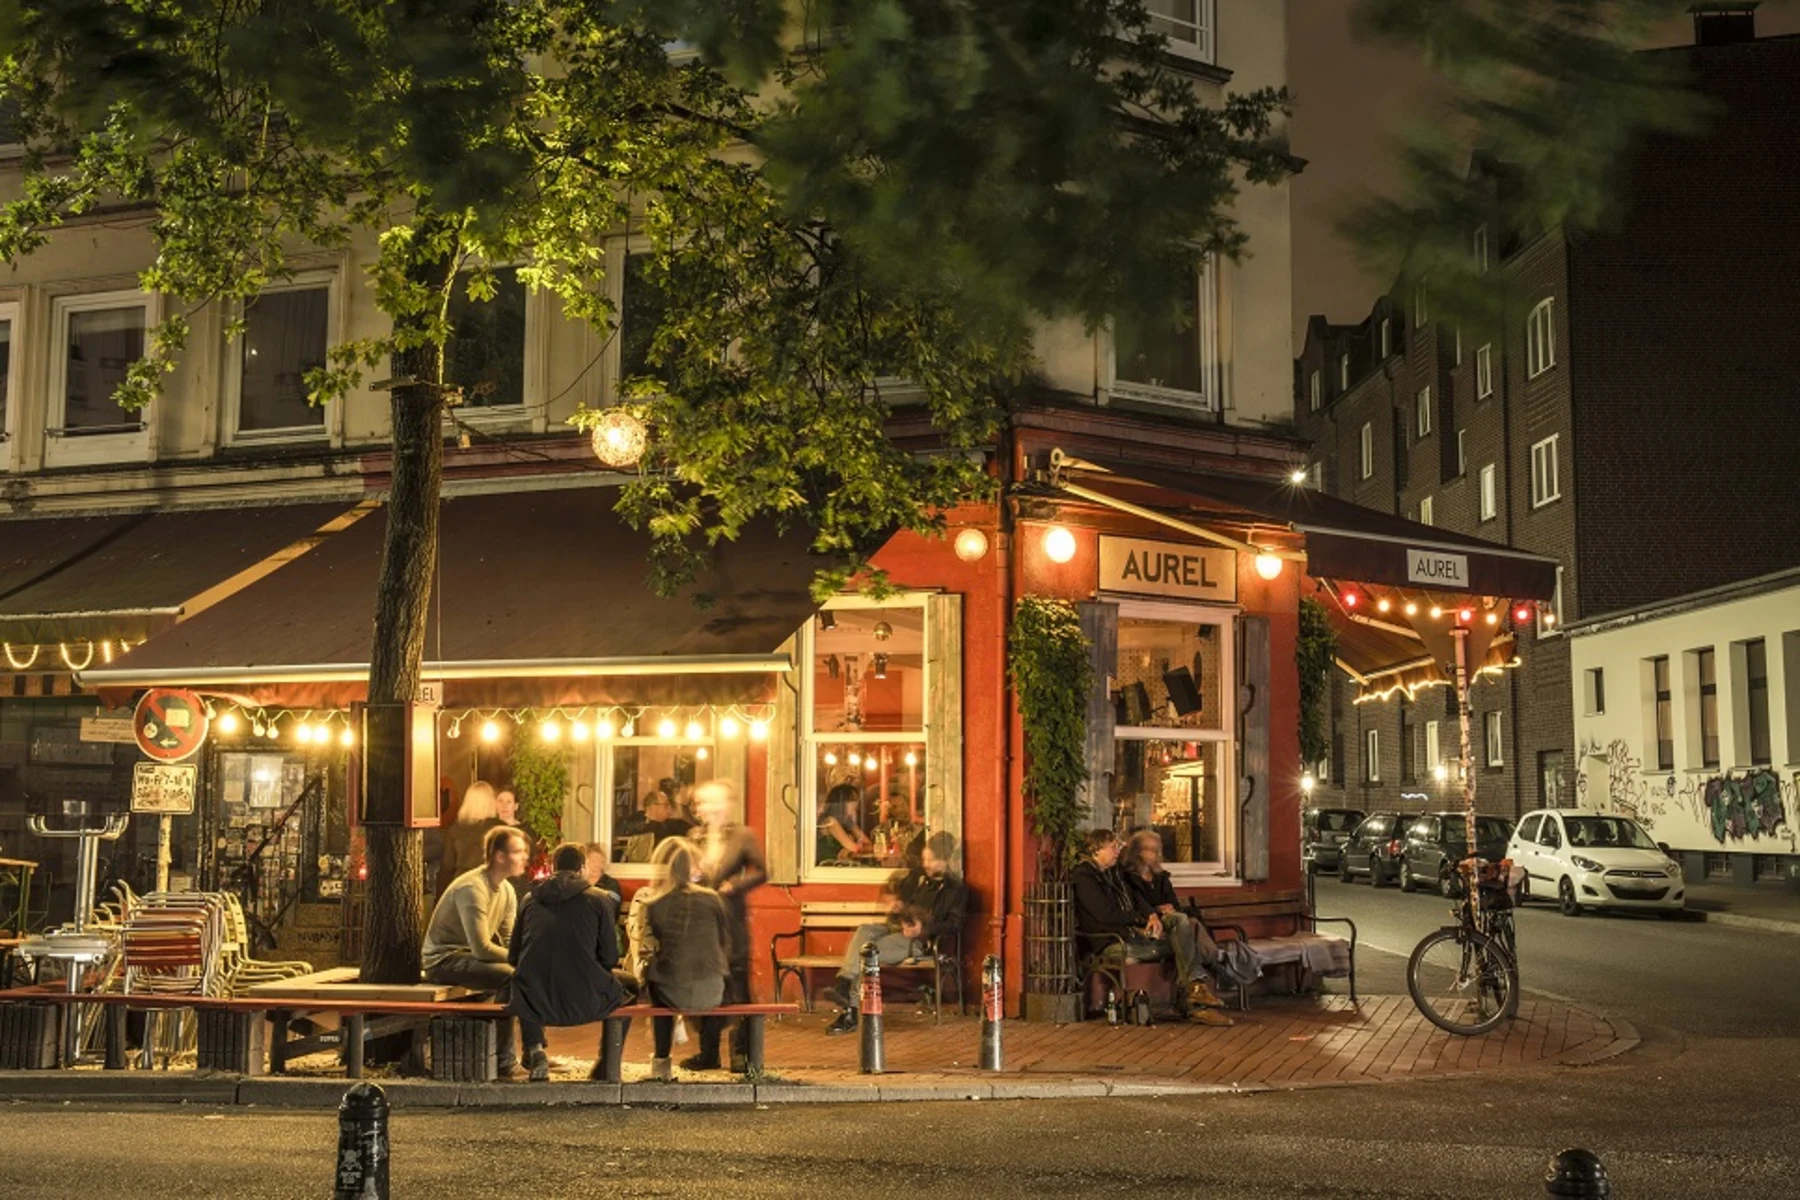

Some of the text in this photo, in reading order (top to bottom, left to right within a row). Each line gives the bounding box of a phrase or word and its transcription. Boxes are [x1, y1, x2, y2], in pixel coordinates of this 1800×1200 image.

[1121, 549, 1217, 588] AUREL
[1415, 557, 1460, 580] AUREL
[418, 686, 435, 702] EL
